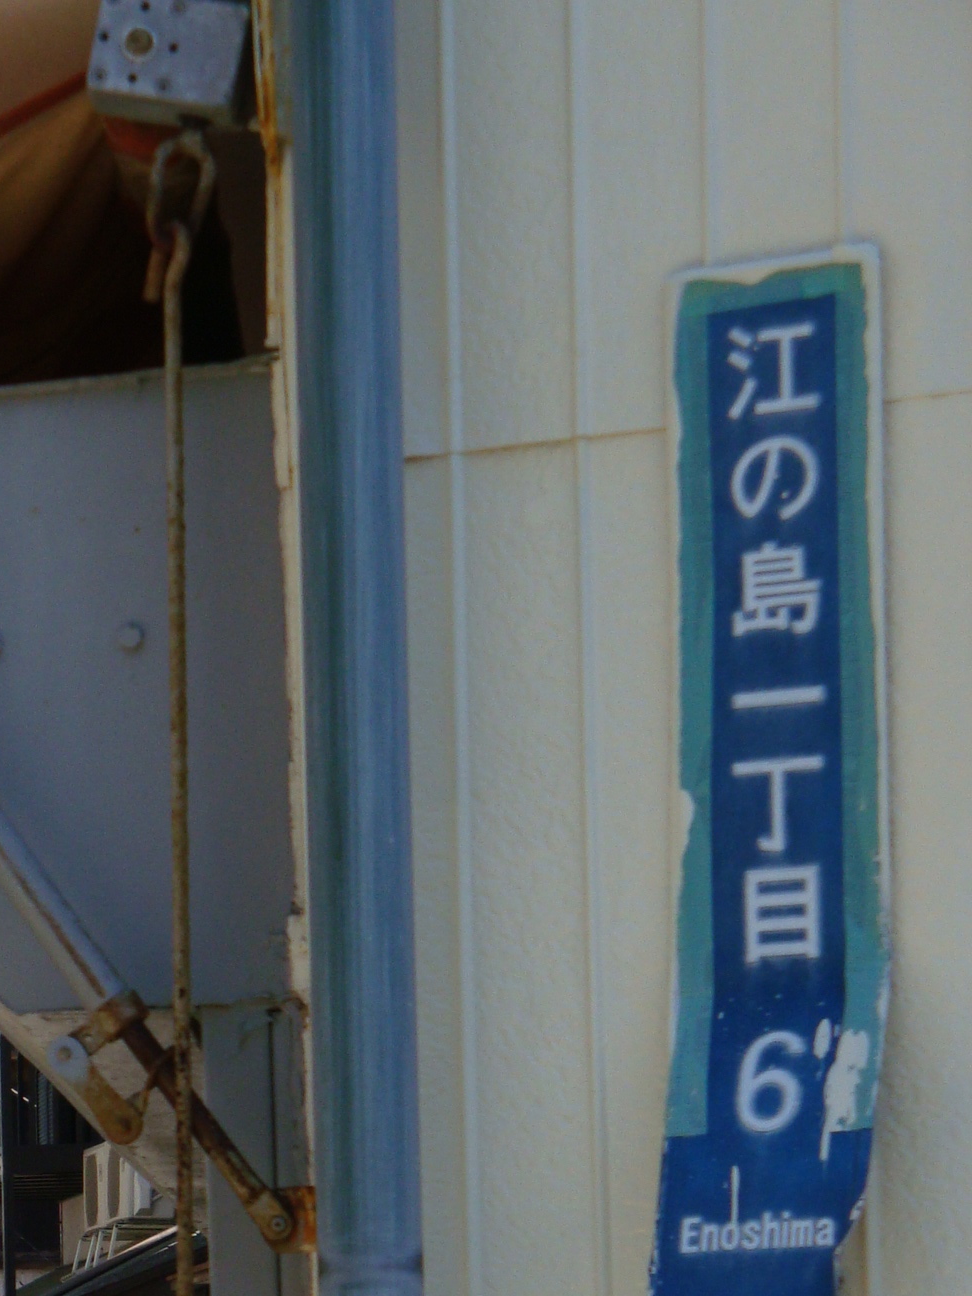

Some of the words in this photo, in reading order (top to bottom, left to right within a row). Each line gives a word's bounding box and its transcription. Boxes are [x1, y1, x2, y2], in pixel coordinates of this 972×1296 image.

[727, 320, 826, 964] 江の島一丁目
[734, 1030, 806, 1134] 6
[679, 1209, 835, 1254] Enoshima
